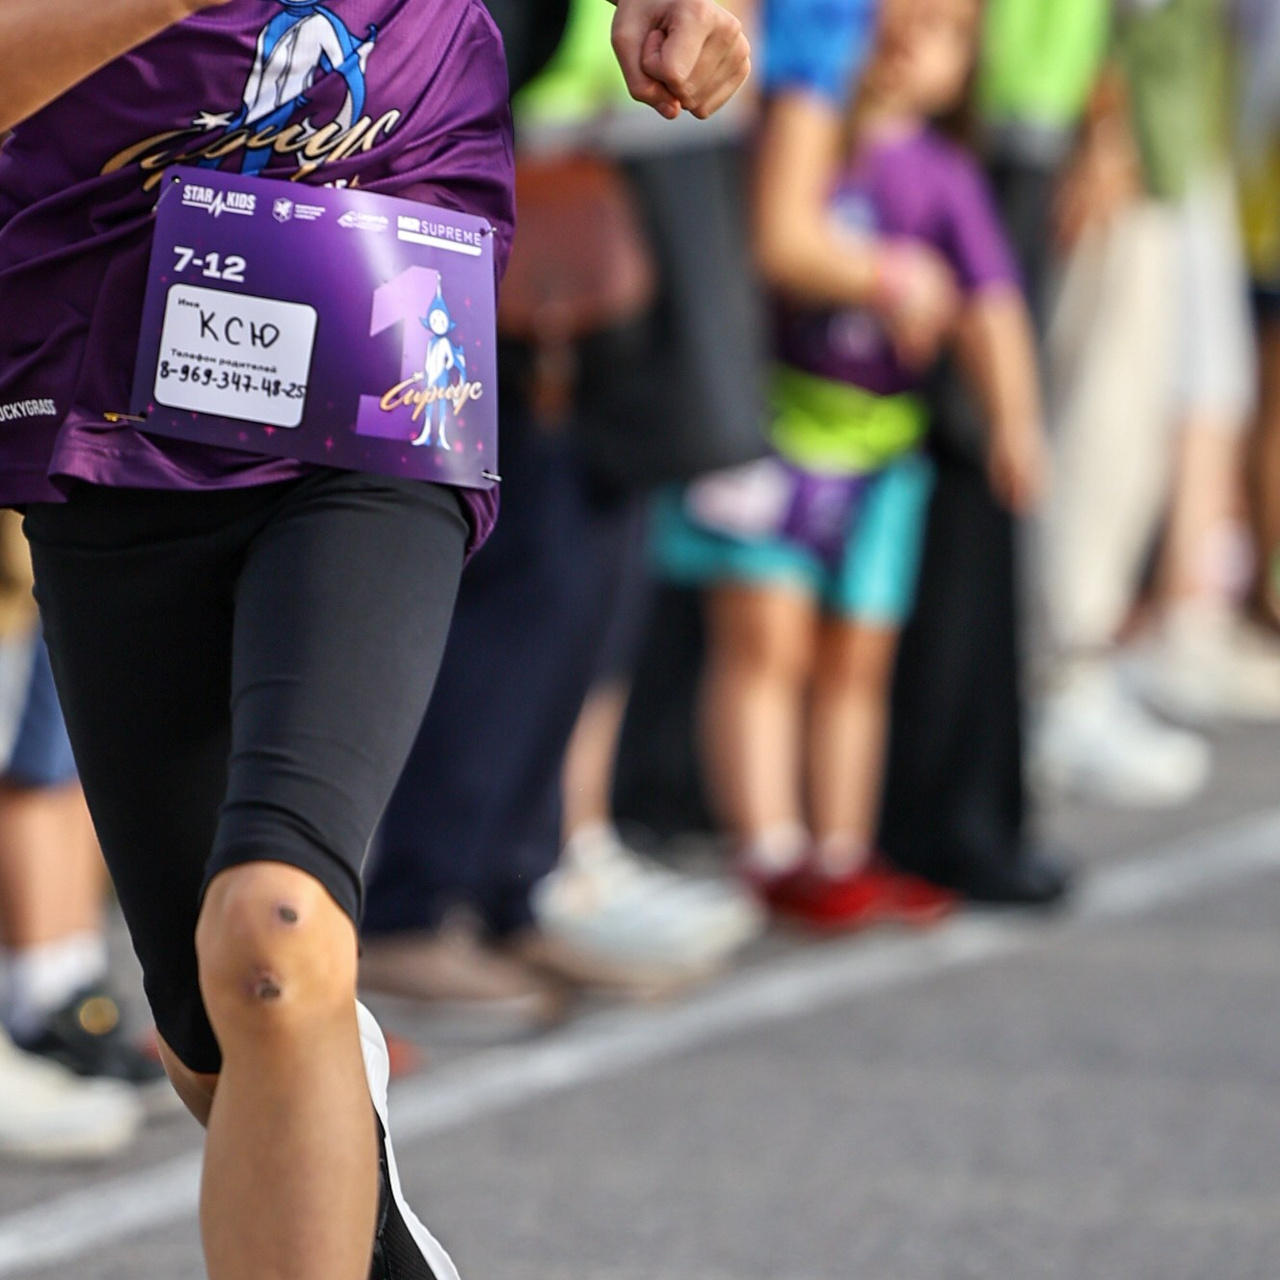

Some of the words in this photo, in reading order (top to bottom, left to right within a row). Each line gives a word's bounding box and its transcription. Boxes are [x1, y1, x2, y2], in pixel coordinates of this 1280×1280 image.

[182, 184, 215, 203] STAR
[226, 191, 257, 211] KIDS
[421, 219, 482, 247] SUPREME
[173, 245, 247, 283] 7-12
[200, 309, 280, 349] КСЮ
